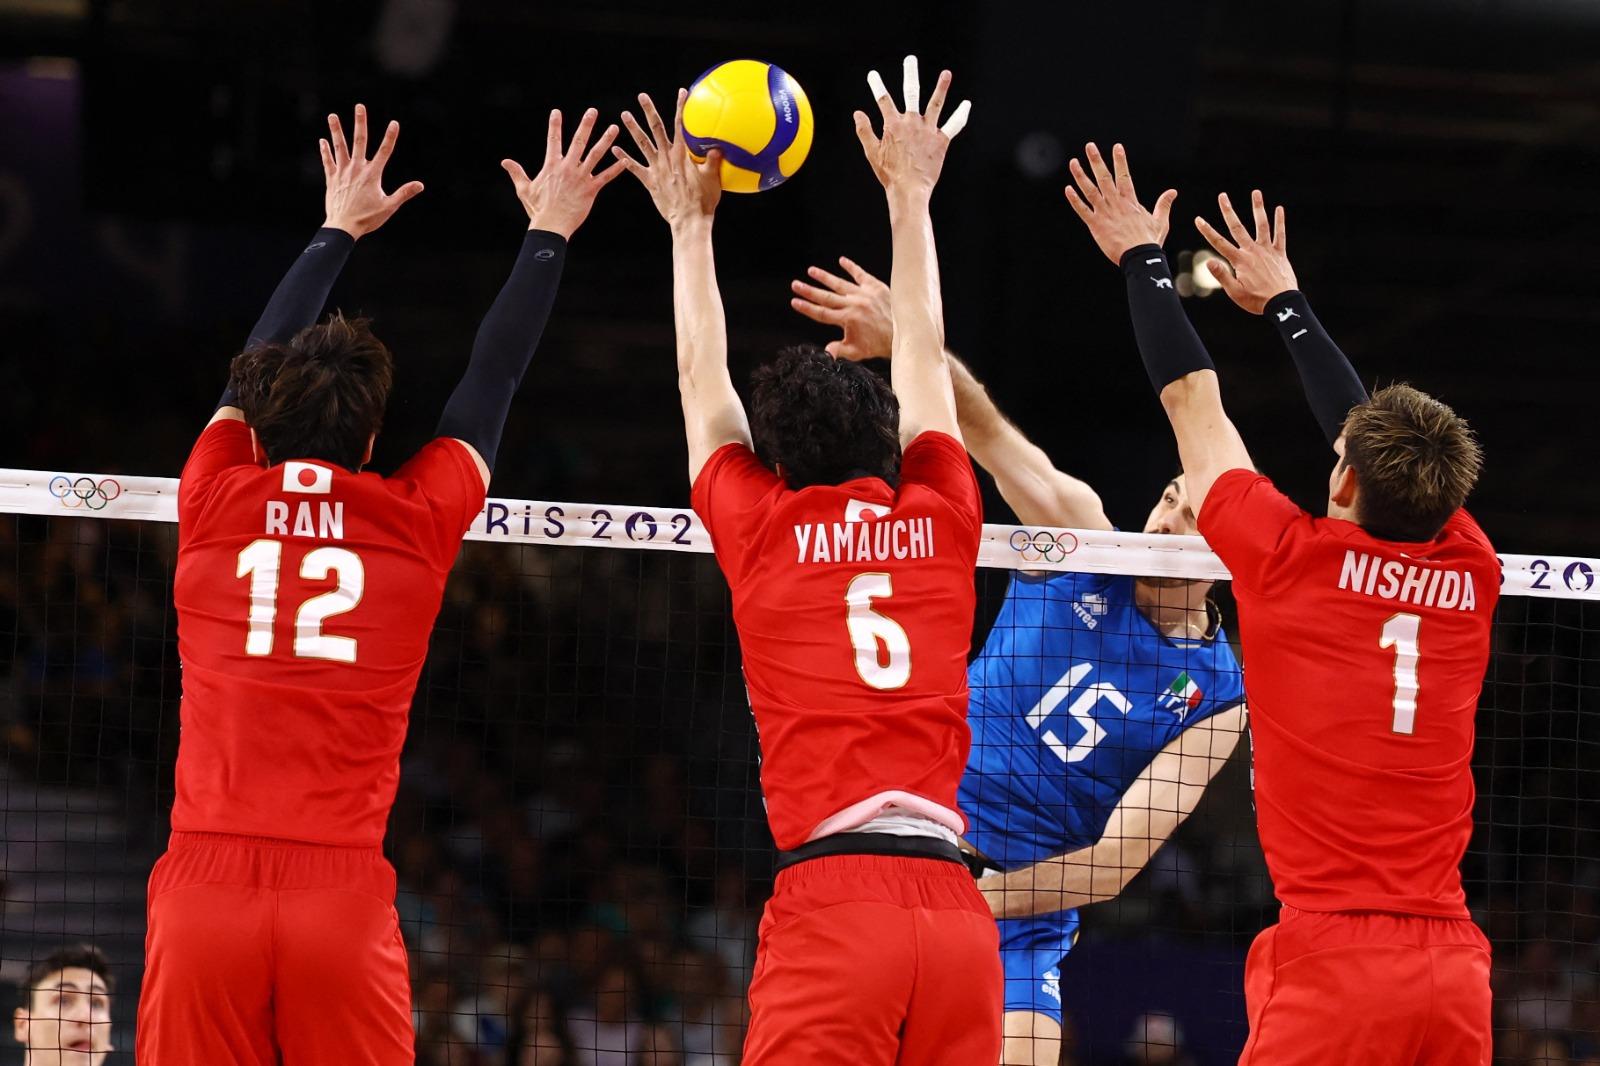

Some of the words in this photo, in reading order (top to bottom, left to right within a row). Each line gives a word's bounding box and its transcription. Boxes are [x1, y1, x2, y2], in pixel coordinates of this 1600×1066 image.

[265, 500, 344, 540] RAN
[793, 517, 934, 564] YAMAUCHI
[236, 539, 365, 664] 12
[1337, 550, 1477, 612] NISHIDA
[844, 571, 913, 691] 6
[1025, 662, 1133, 763] 15
[1157, 688, 1189, 723] ITA
[1378, 611, 1422, 737] 1
